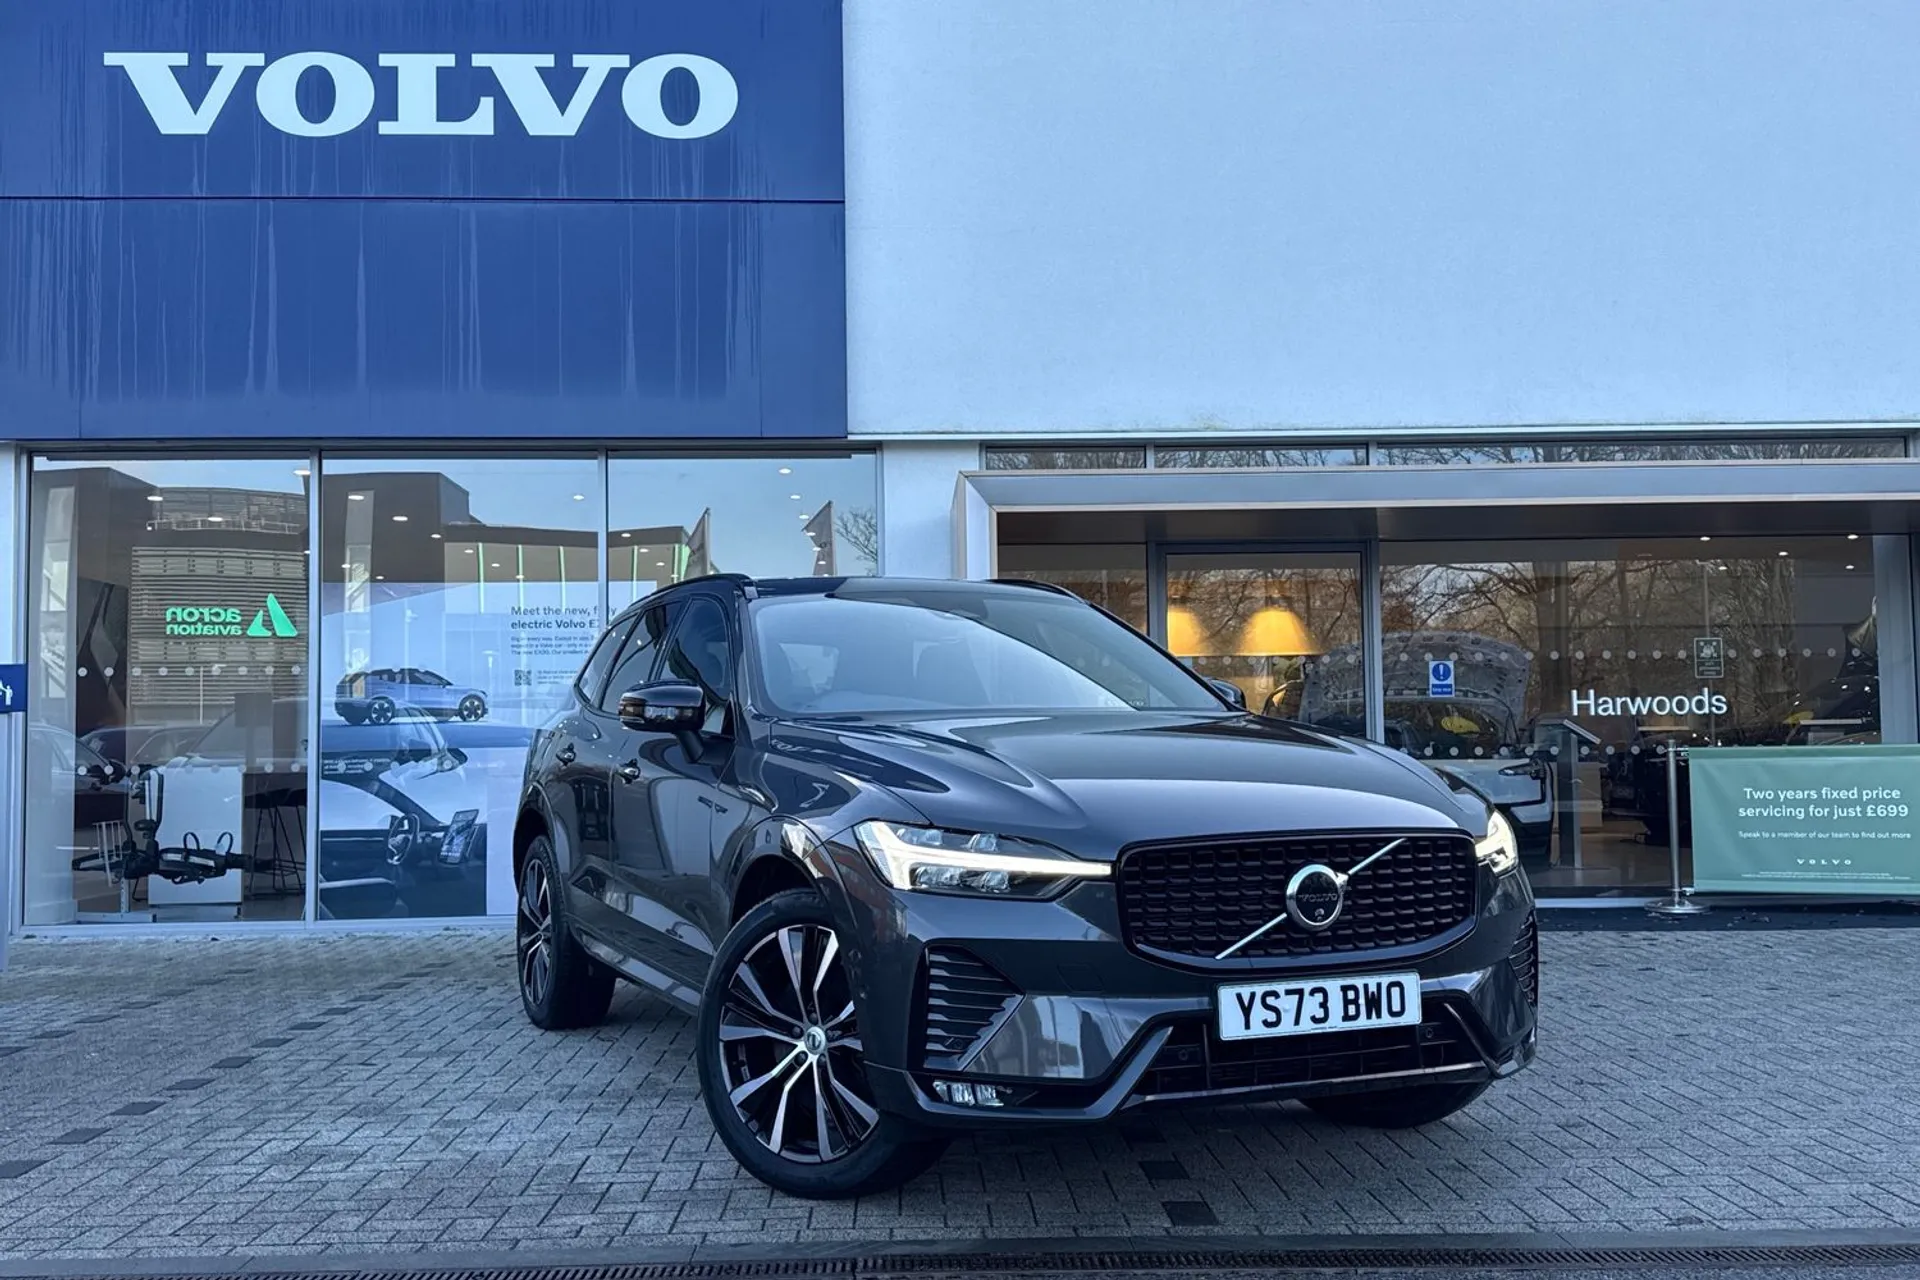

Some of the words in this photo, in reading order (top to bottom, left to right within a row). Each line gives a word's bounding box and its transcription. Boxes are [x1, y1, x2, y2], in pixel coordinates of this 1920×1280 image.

[103, 51, 739, 140] VOLVO
[511, 606, 540, 616] Meet
[543, 606, 561, 616] the
[564, 607, 590, 617] new,
[511, 619, 552, 629] electric
[555, 619, 586, 629] Volvo
[1571, 687, 1728, 716] Harwoods
[1743, 788, 1774, 800] Two
[1778, 788, 1818, 802] years
[1822, 787, 1858, 800] fixed
[1863, 787, 1901, 802] price
[1738, 805, 1805, 820] servicing
[1809, 804, 1830, 817] for
[1833, 804, 1862, 820] just
[1866, 804, 1909, 818] £699
[1738, 831, 1760, 840] Speak
[1762, 831, 1770, 839] to
[1808, 831, 1817, 839] of
[1861, 831, 1876, 839] find
[1891, 832, 1911, 840] more
[1796, 858, 1852, 866] VOLVO
[1236, 987, 1330, 1031] YS73
[1340, 981, 1406, 1023] BWO
